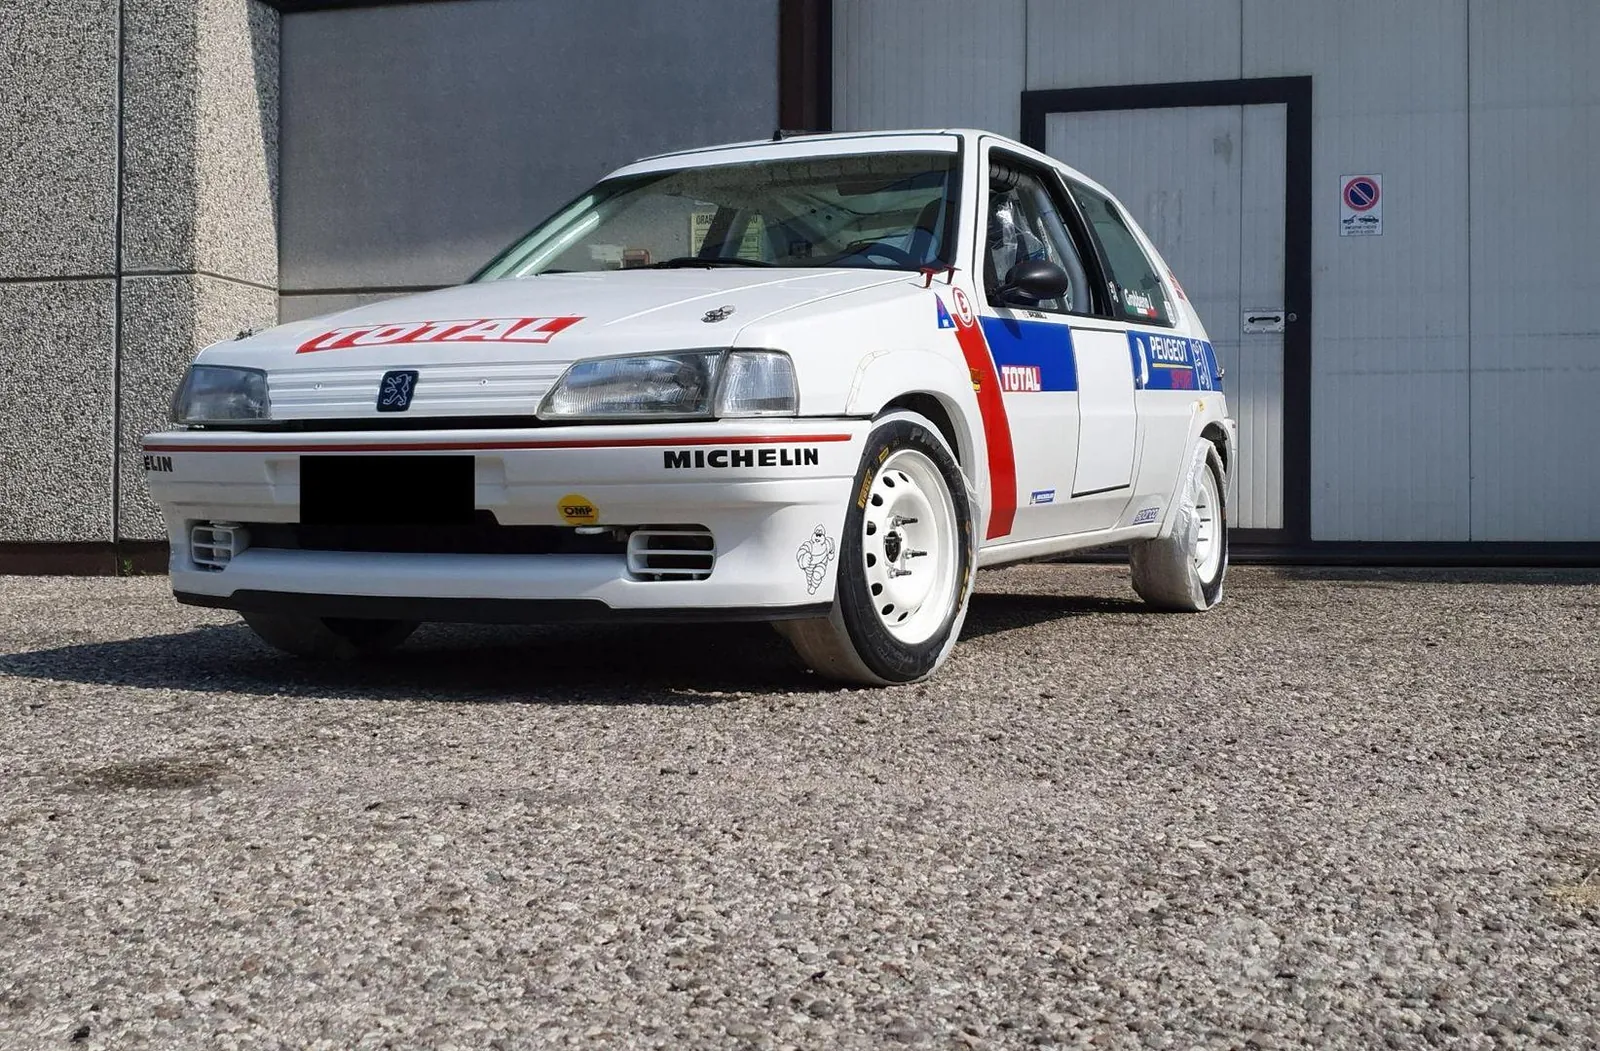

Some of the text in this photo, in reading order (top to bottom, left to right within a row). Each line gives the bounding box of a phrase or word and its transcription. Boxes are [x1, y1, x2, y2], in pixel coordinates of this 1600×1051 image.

[312, 317, 562, 349] TOTAL
[1149, 336, 1188, 362] PEUGEOT
[1001, 366, 1041, 391] TOTAL
[143, 455, 173, 472] ELIN
[664, 448, 819, 468] MICHELIN
[564, 507, 593, 515] OMP
